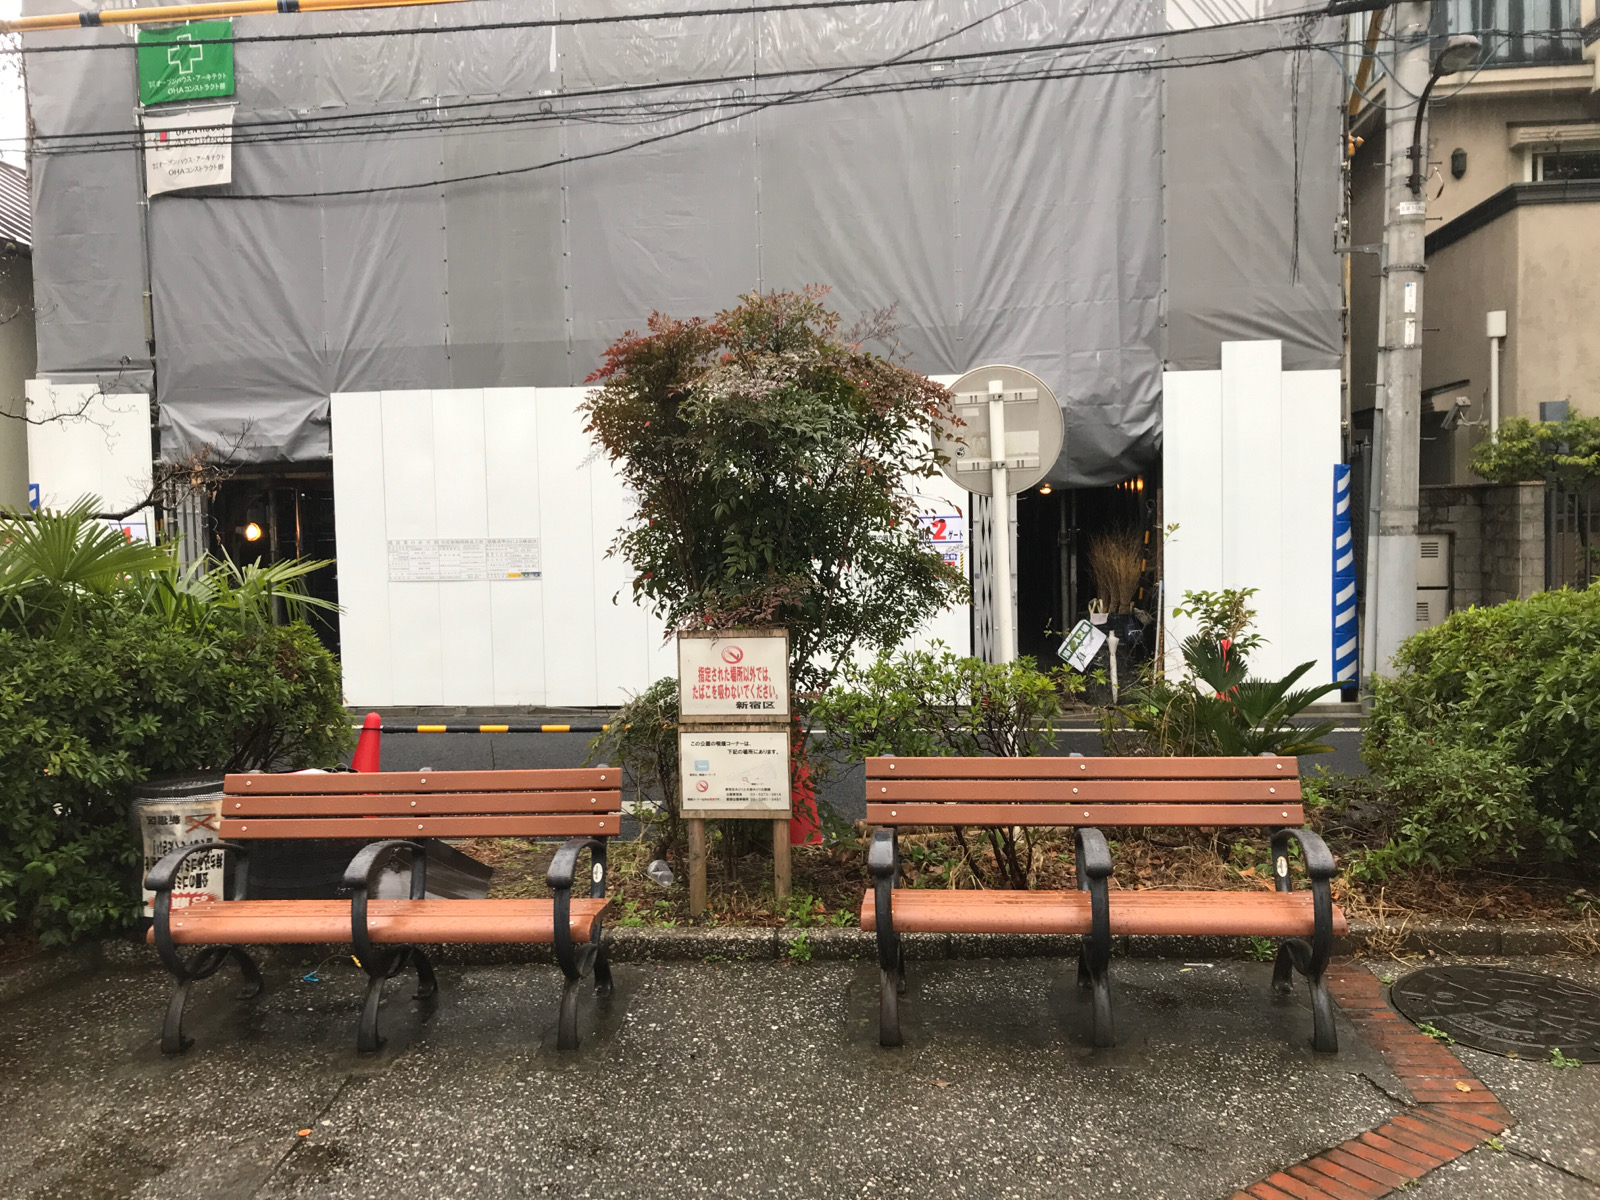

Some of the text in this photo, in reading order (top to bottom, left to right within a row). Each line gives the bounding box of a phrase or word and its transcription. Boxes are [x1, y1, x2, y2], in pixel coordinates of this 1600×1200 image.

[692, 684, 778, 699] たばこを吸わないでください。
[735, 701, 775, 709] 新宿区
